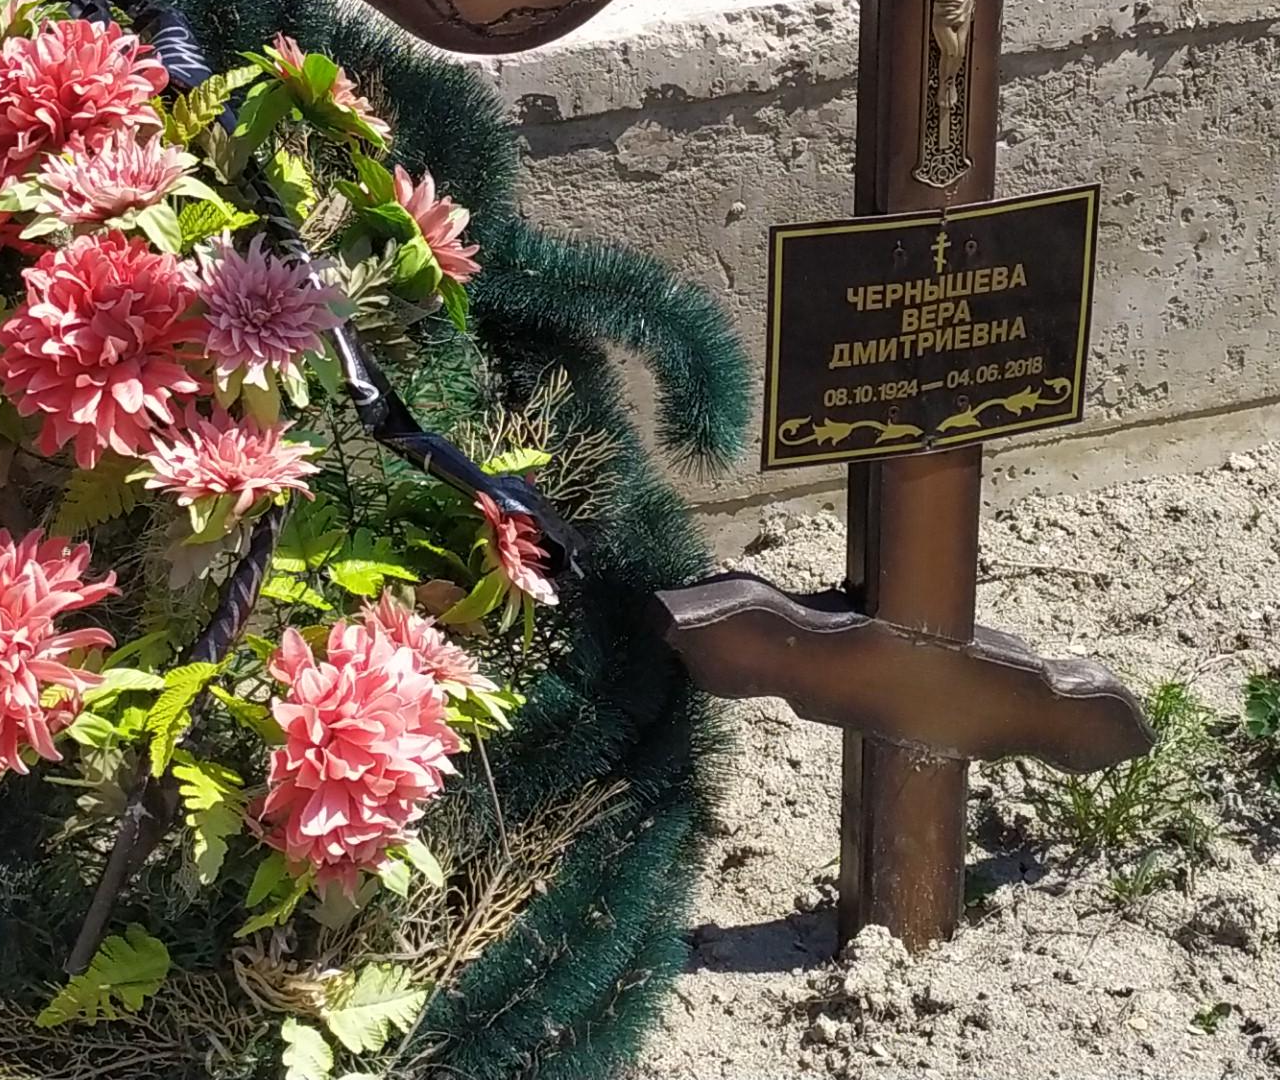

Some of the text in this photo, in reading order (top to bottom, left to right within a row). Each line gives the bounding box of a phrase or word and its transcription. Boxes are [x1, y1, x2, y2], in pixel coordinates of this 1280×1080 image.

[847, 263, 1028, 311] ЧЕРНЫШЕВА
[901, 299, 971, 332] ВЕРА
[829, 316, 1027, 370] ДМИТРИЕВНА
[823, 378, 918, 408] 08.10.1924
[946, 356, 1043, 389] 04.06.2018
